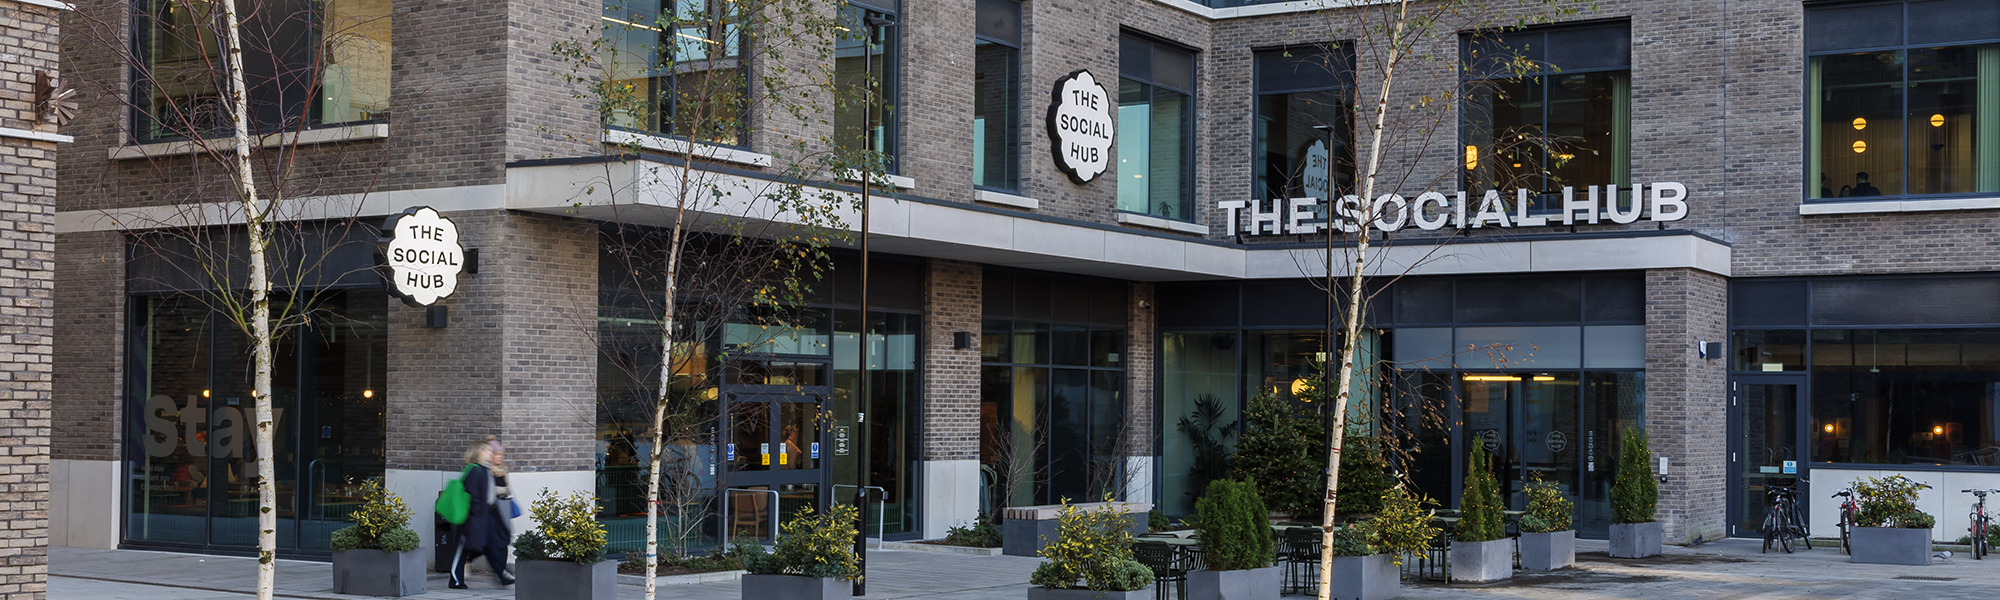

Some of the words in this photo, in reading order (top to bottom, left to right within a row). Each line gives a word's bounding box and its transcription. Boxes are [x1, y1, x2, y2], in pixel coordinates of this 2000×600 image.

[1072, 90, 1099, 111] THE
[1060, 114, 1109, 140] SOCIAL
[1070, 142, 1099, 163] HUB
[1218, 196, 1318, 236] THE
[1334, 188, 1547, 232] SOCIAL
[1563, 181, 1689, 225] HUB
[409, 225, 444, 242] THE
[393, 247, 458, 266] SOCIAL
[406, 271, 444, 289] HUB
[143, 394, 284, 478] Stay
